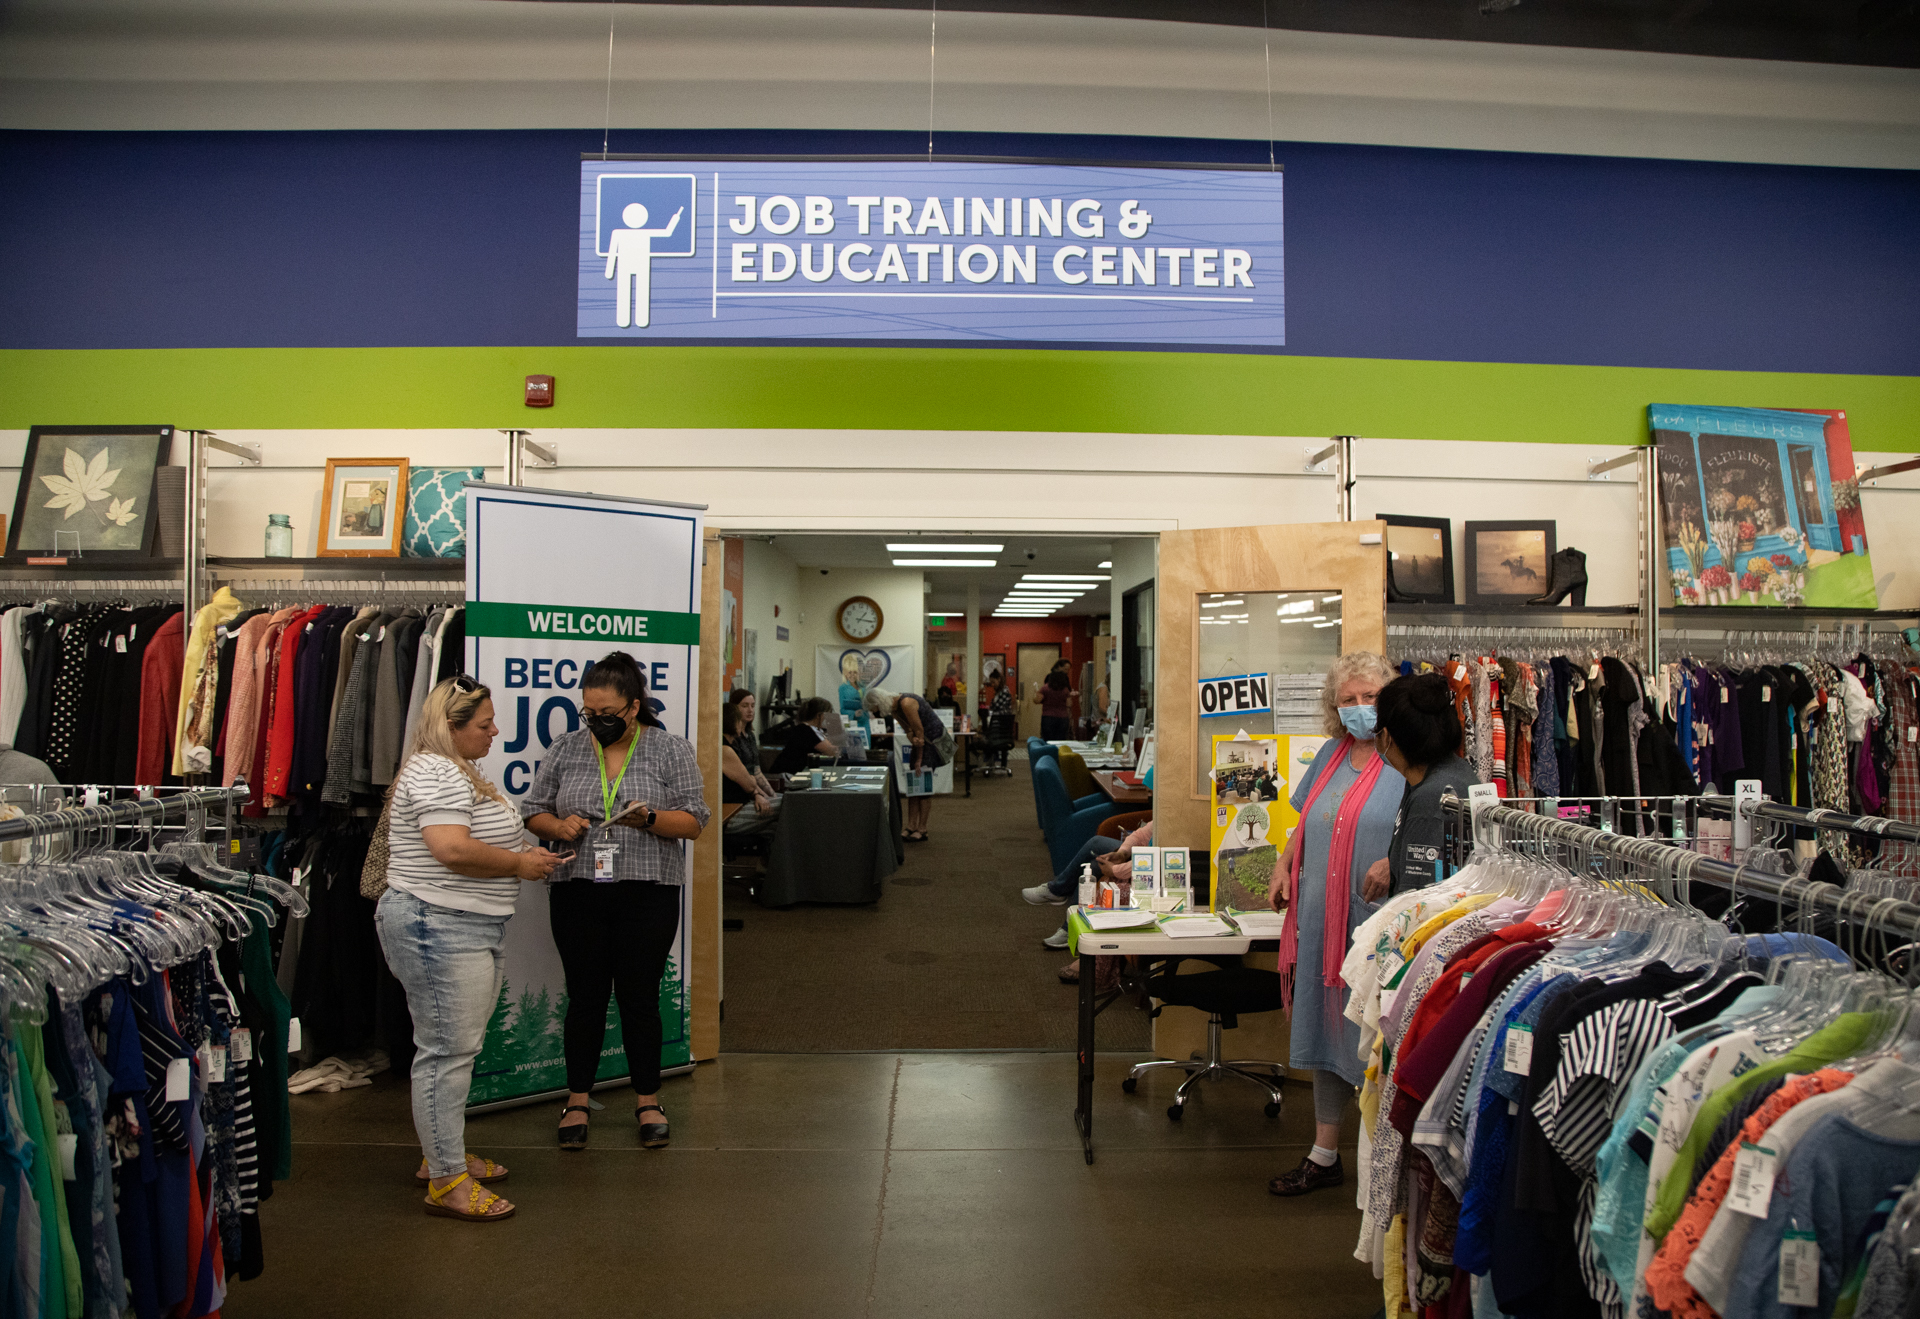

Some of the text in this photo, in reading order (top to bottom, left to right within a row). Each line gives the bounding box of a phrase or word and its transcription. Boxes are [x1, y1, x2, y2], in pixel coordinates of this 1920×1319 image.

[729, 195, 1153, 240] JOB TRAINING &
[731, 243, 1255, 288] EDUCATION CENTER
[1696, 415, 1804, 439] FLEURS
[1706, 450, 1774, 472] FLEURISTE
[527, 611, 648, 637] WELCOME
[1201, 678, 1268, 712] OPEN
[1474, 789, 1492, 798] SMALL
[1742, 784, 1756, 793] XL
[1413, 852, 1424, 860] Way
